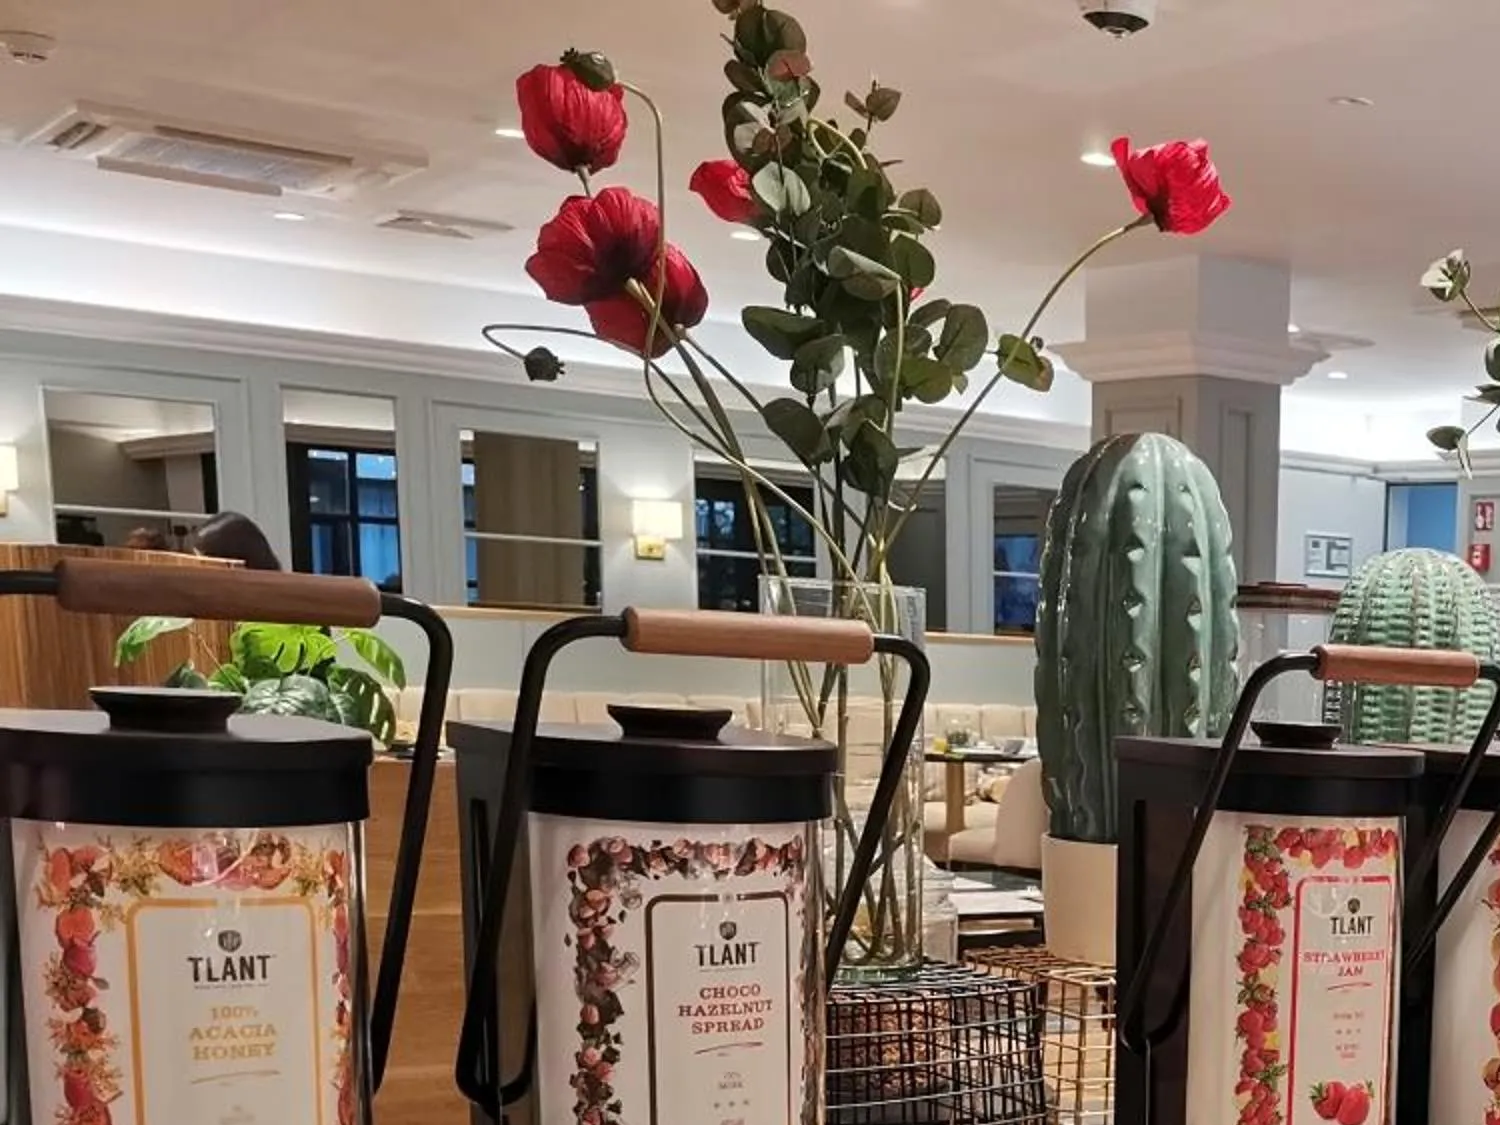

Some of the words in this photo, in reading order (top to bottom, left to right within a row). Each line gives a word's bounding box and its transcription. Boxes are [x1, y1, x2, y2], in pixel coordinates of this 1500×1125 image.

[1330, 916, 1375, 935] TLANT
[693, 942, 761, 967] TLANT
[187, 954, 272, 983] TLANT
[699, 983, 761, 1000] CHOCO
[678, 999, 773, 1017] HAZELNUT
[189, 1023, 277, 1041] ACACIA
[691, 1017, 765, 1035] SPREAD
[192, 1042, 276, 1061] HONEY
